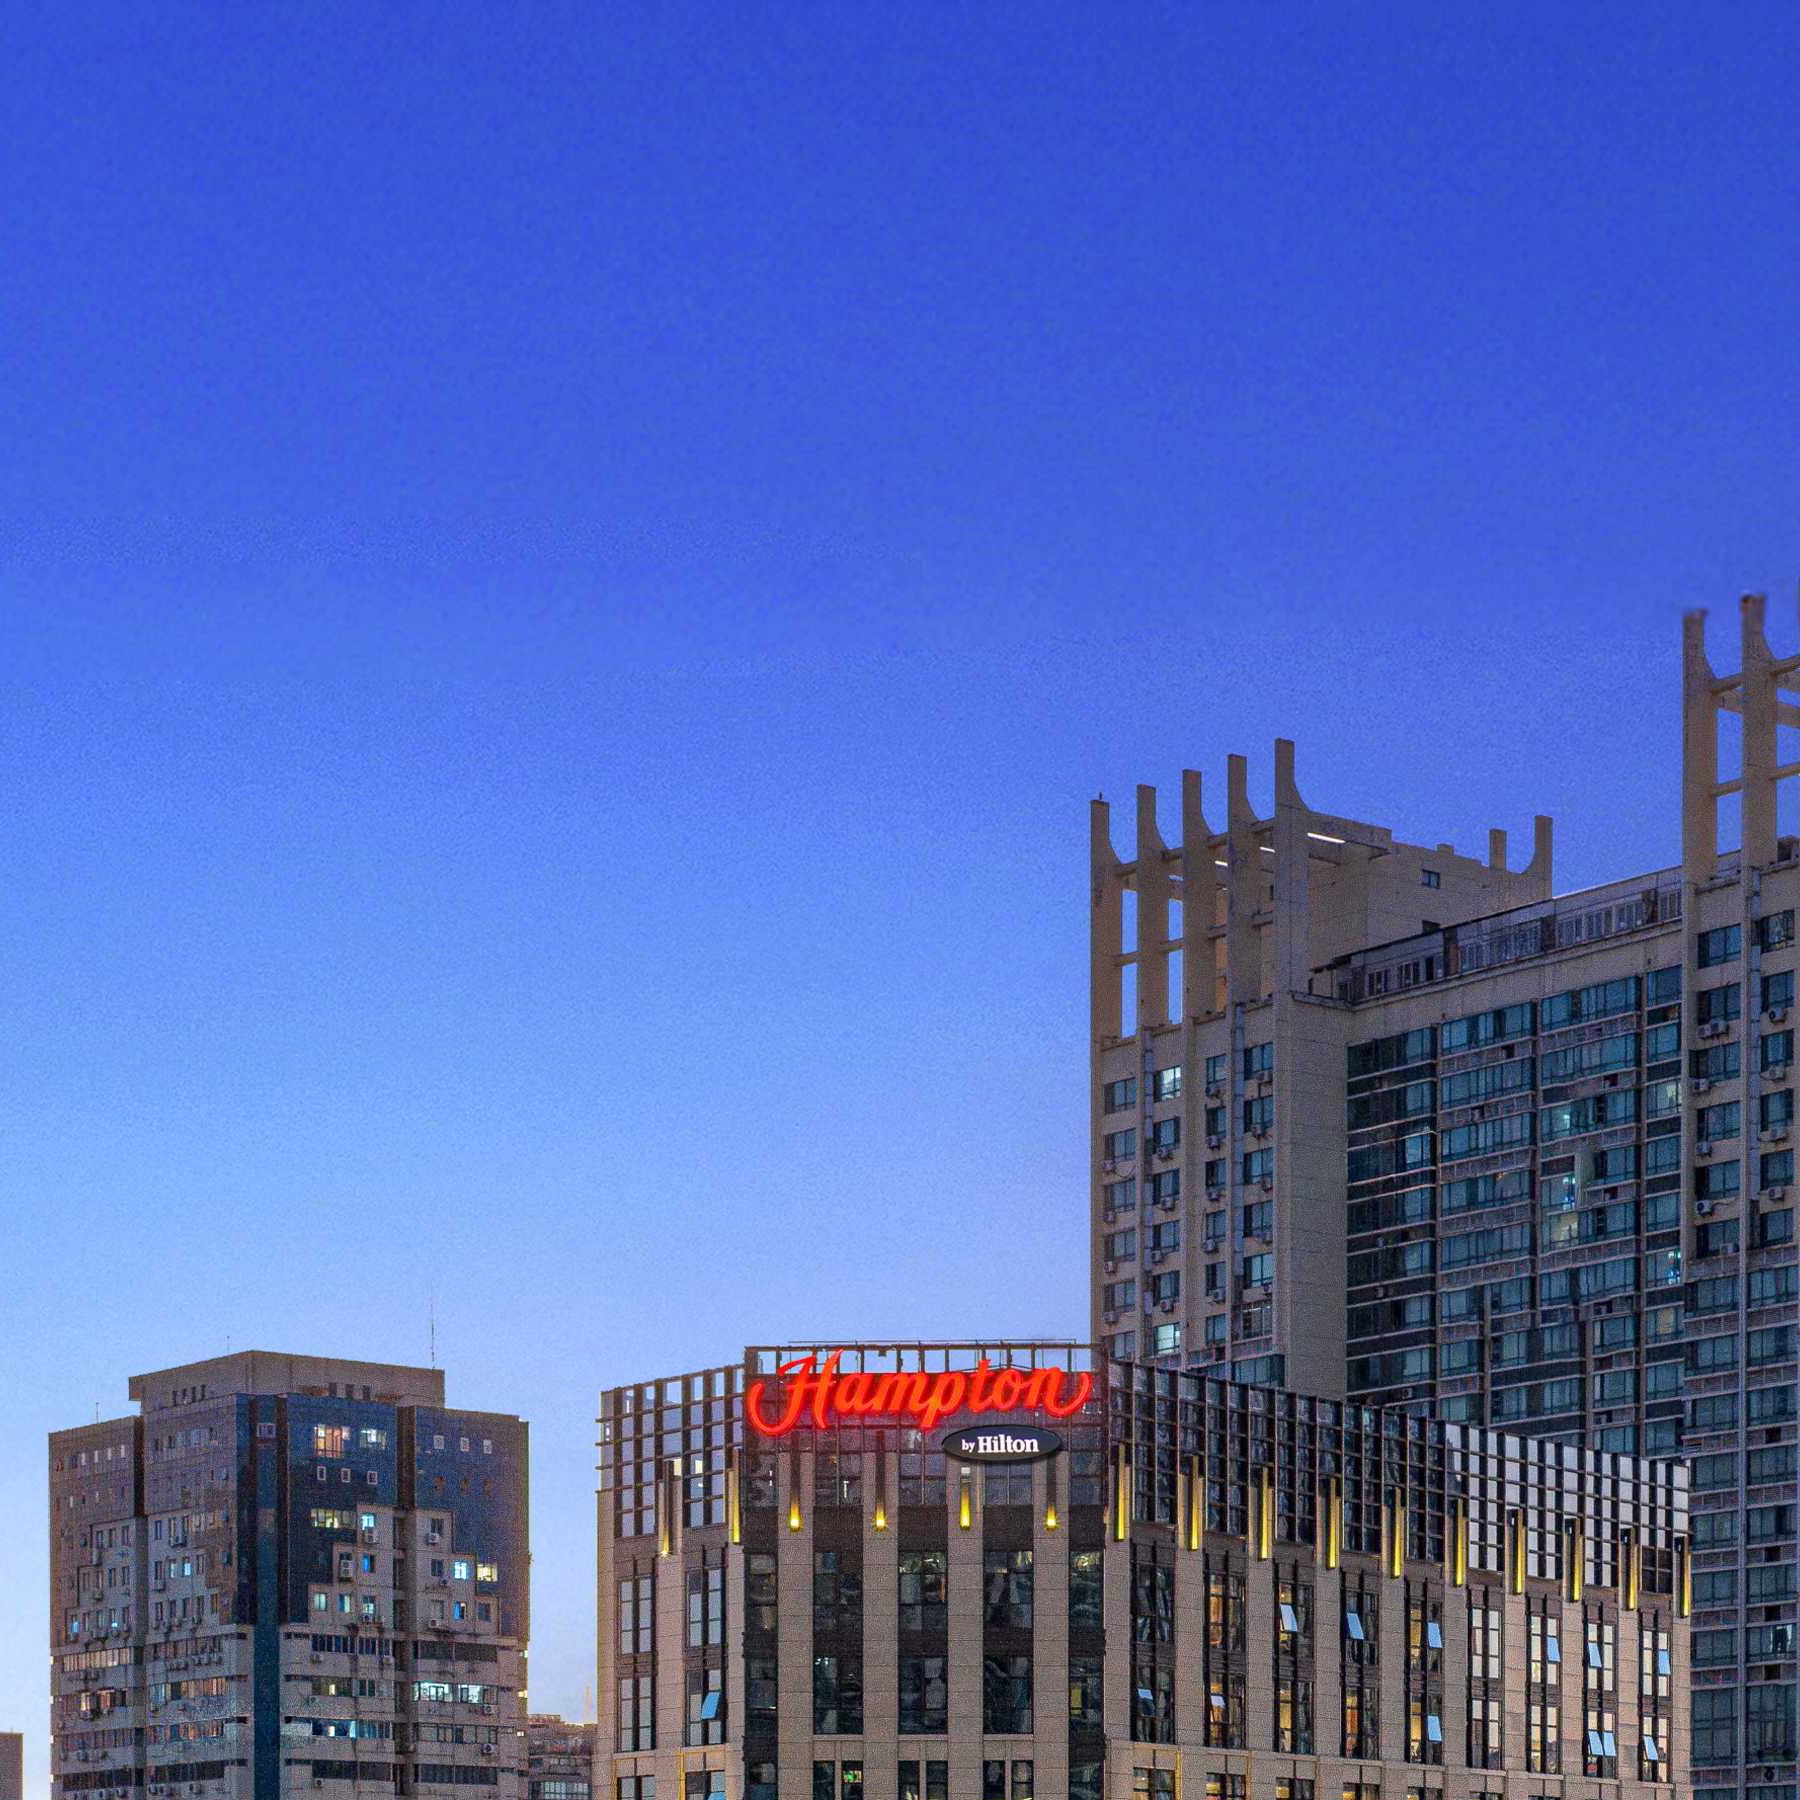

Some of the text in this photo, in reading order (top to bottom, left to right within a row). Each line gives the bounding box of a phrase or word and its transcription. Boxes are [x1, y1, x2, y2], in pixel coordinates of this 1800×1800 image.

[747, 1348, 1092, 1436] Hampton
[961, 1434, 1040, 1453] by Hilton
